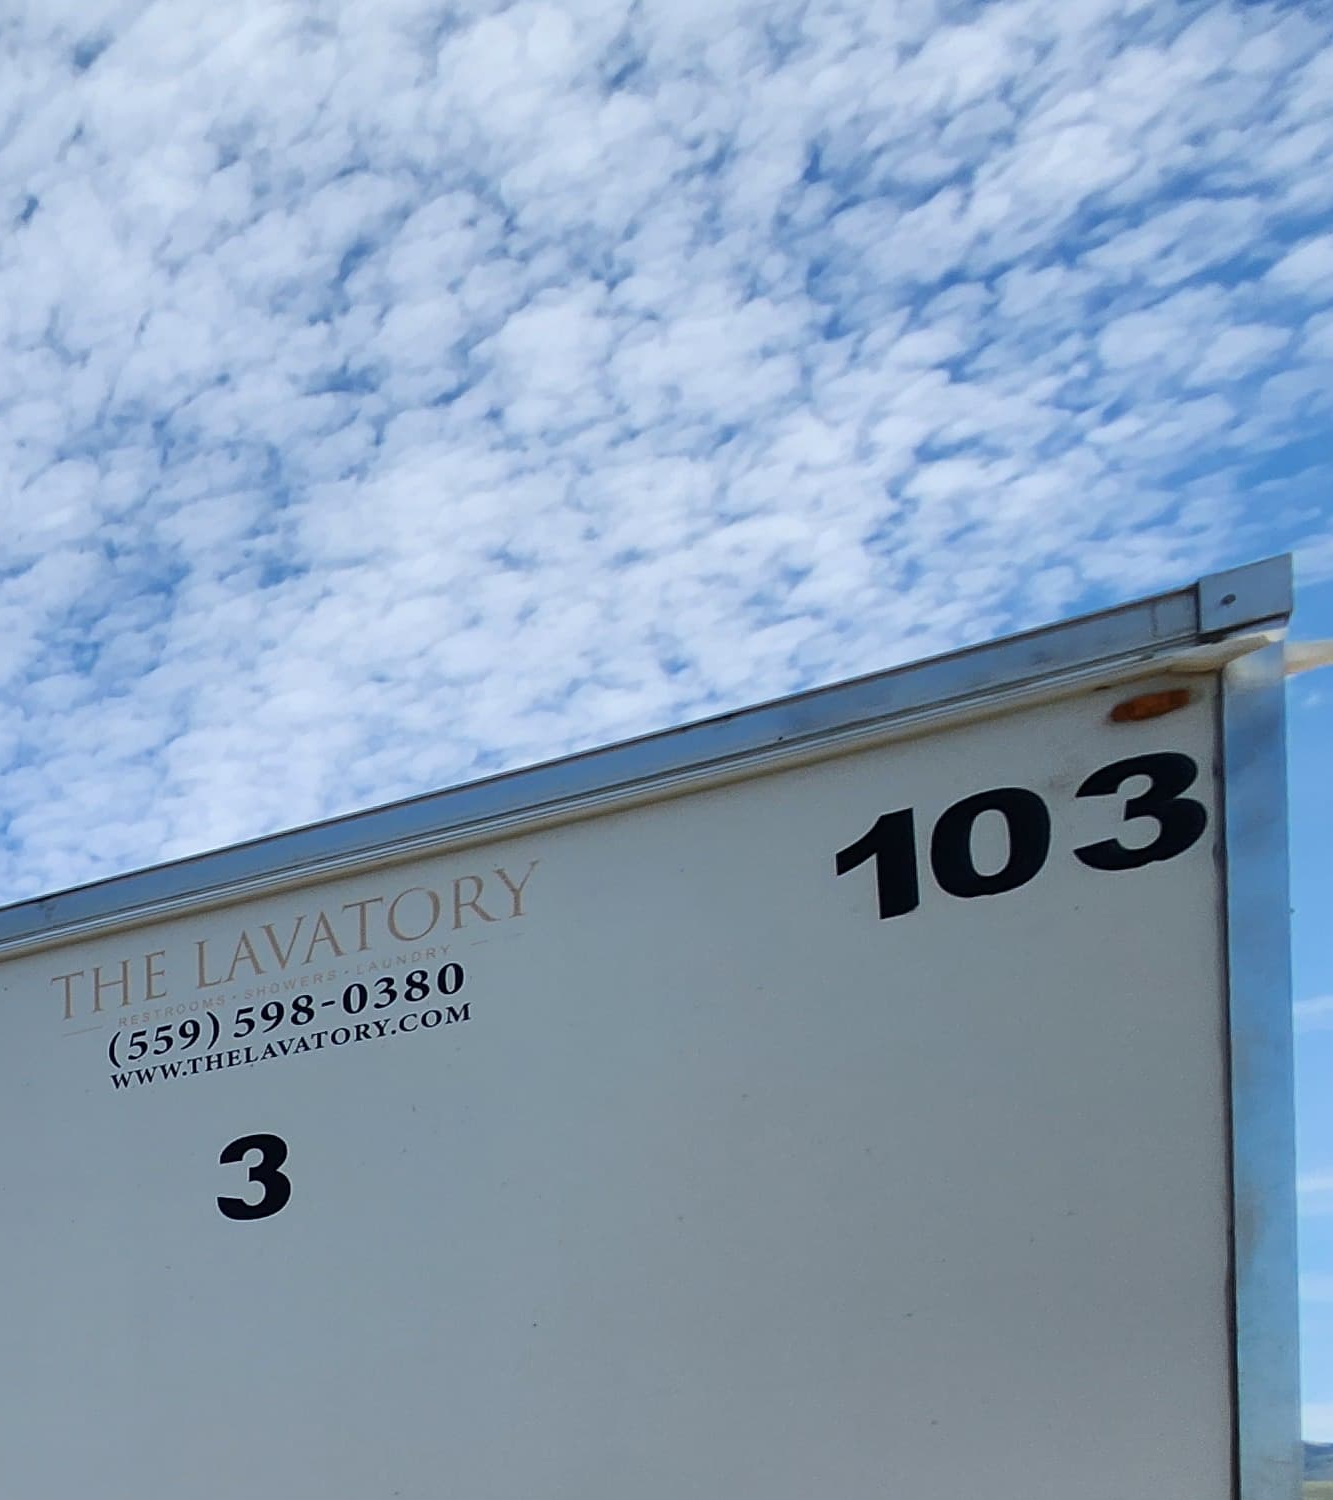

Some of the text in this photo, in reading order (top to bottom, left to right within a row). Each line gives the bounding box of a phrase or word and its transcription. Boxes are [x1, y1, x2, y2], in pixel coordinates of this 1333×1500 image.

[835, 751, 1209, 920] 103
[50, 858, 540, 1020] THE LAVATORY
[117, 943, 452, 1027] RESTROOMS SHOWERS LAUNDRY
[108, 962, 465, 1068] (559) 598-0380
[110, 1002, 472, 1090] WWW.THELAVATORY.COM
[216, 1132, 292, 1220] 3
